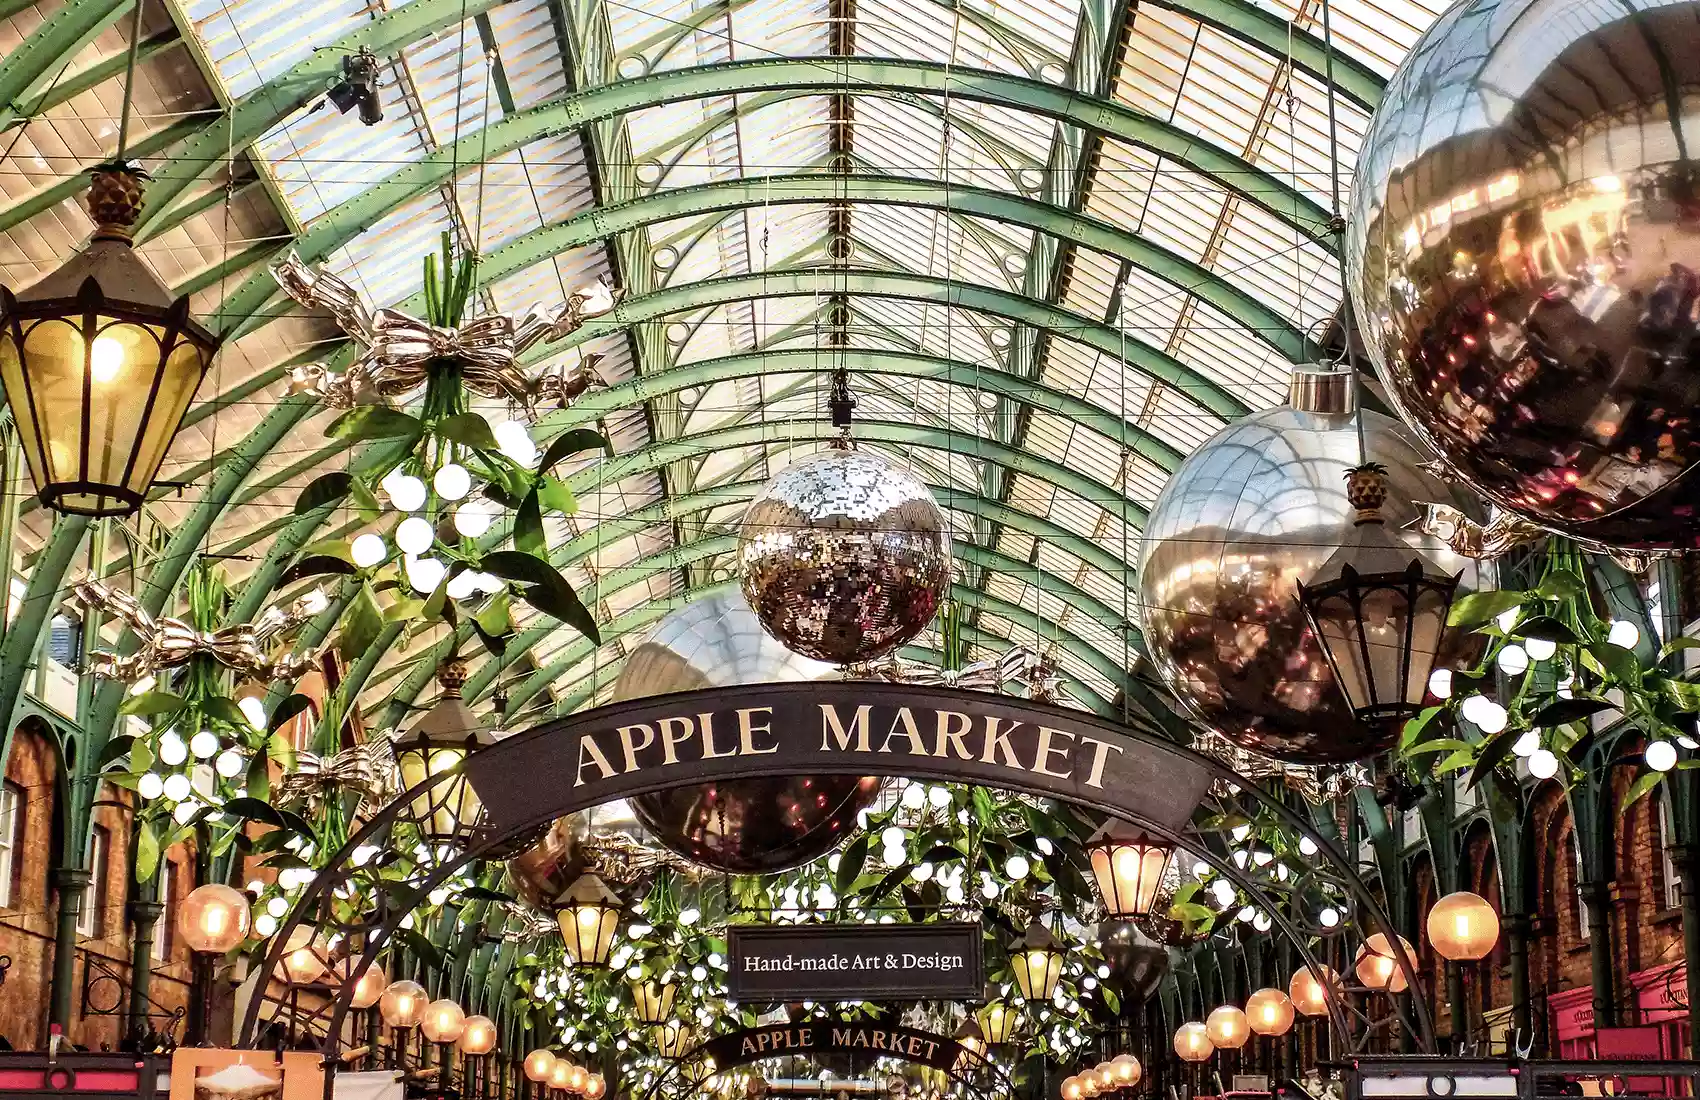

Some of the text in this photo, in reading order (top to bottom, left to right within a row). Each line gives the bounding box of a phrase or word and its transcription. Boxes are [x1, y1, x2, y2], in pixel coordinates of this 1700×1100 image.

[573, 703, 1124, 790] APPLE MARKET
[744, 952, 964, 972] Hand-made Art & Design
[740, 1028, 939, 1060] APPLE MARKET
